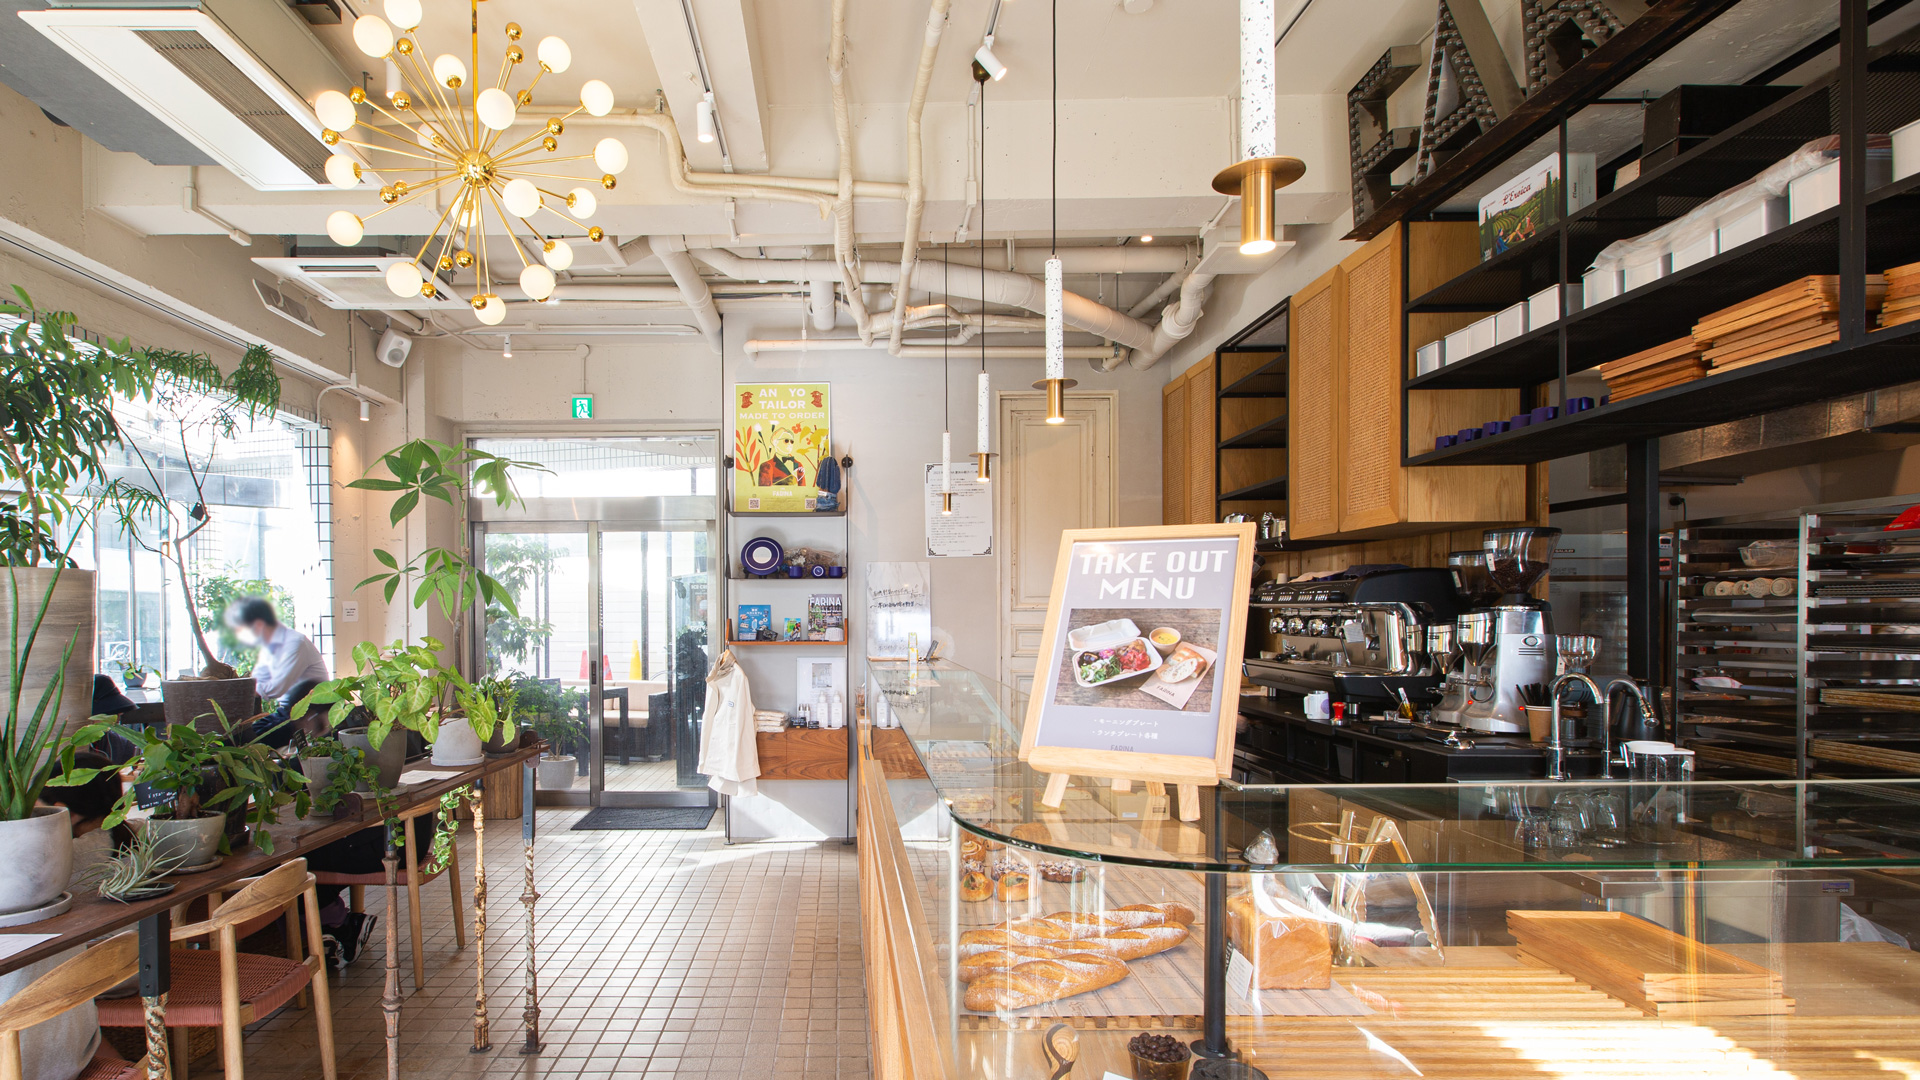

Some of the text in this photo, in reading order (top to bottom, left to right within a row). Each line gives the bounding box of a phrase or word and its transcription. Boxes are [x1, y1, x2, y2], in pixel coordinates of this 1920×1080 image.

[759, 388, 806, 398] AN YO
[759, 400, 806, 409] TAILOR
[739, 412, 769, 420] MADE
[1080, 550, 1229, 575] TAKE OUT
[1099, 577, 1196, 600] MENU
[809, 596, 842, 606] FARINA
[1110, 744, 1134, 753] FARINA
